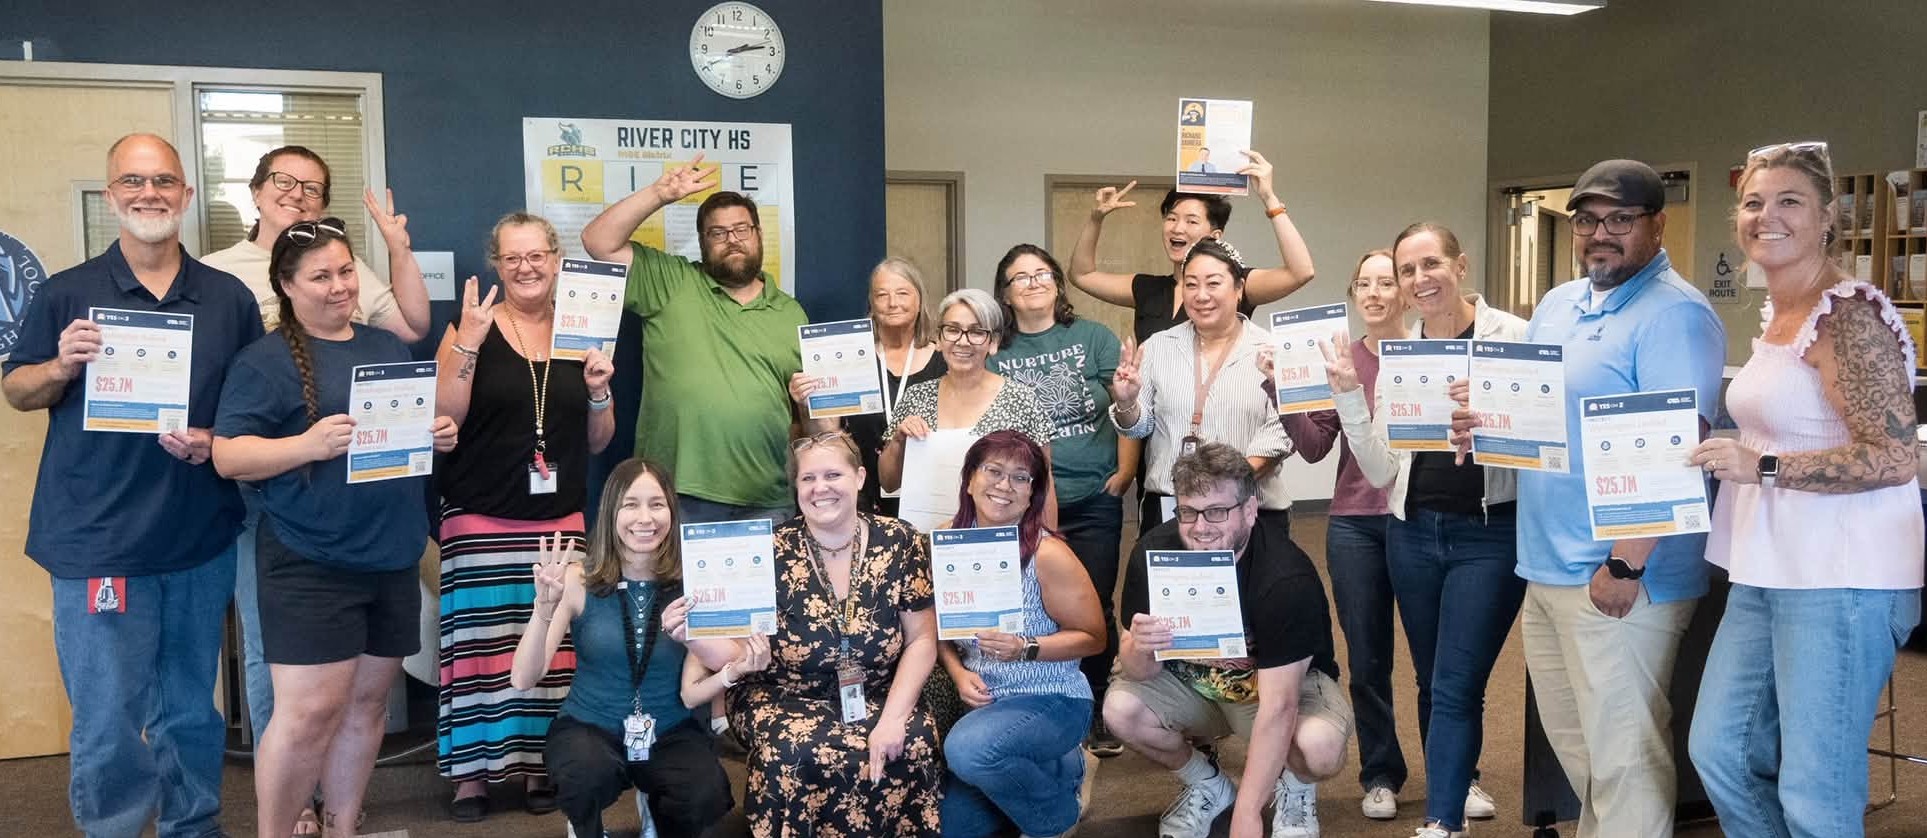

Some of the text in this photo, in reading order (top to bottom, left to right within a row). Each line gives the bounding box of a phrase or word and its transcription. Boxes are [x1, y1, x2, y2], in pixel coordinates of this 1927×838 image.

[717, 14, 725, 25] 11
[732, 10, 742, 21] 12
[701, 44, 708, 54] 9
[769, 46, 776, 57] 3
[736, 80, 742, 90] 6
[753, 75, 759, 85] 5
[618, 127, 751, 150] RIVER CITY HS
[561, 165, 758, 192] R I E
[1714, 280, 1731, 288] EXIT
[1709, 288, 1737, 297] ROUTE
[998, 343, 1084, 372] NURTURE
[95, 375, 133, 393] $25.7M
[1390, 402, 1422, 417] $25.7M
[356, 428, 388, 446] $25.7M
[1595, 474, 1638, 496] $25.7M
[942, 591, 975, 606] $25.7M
